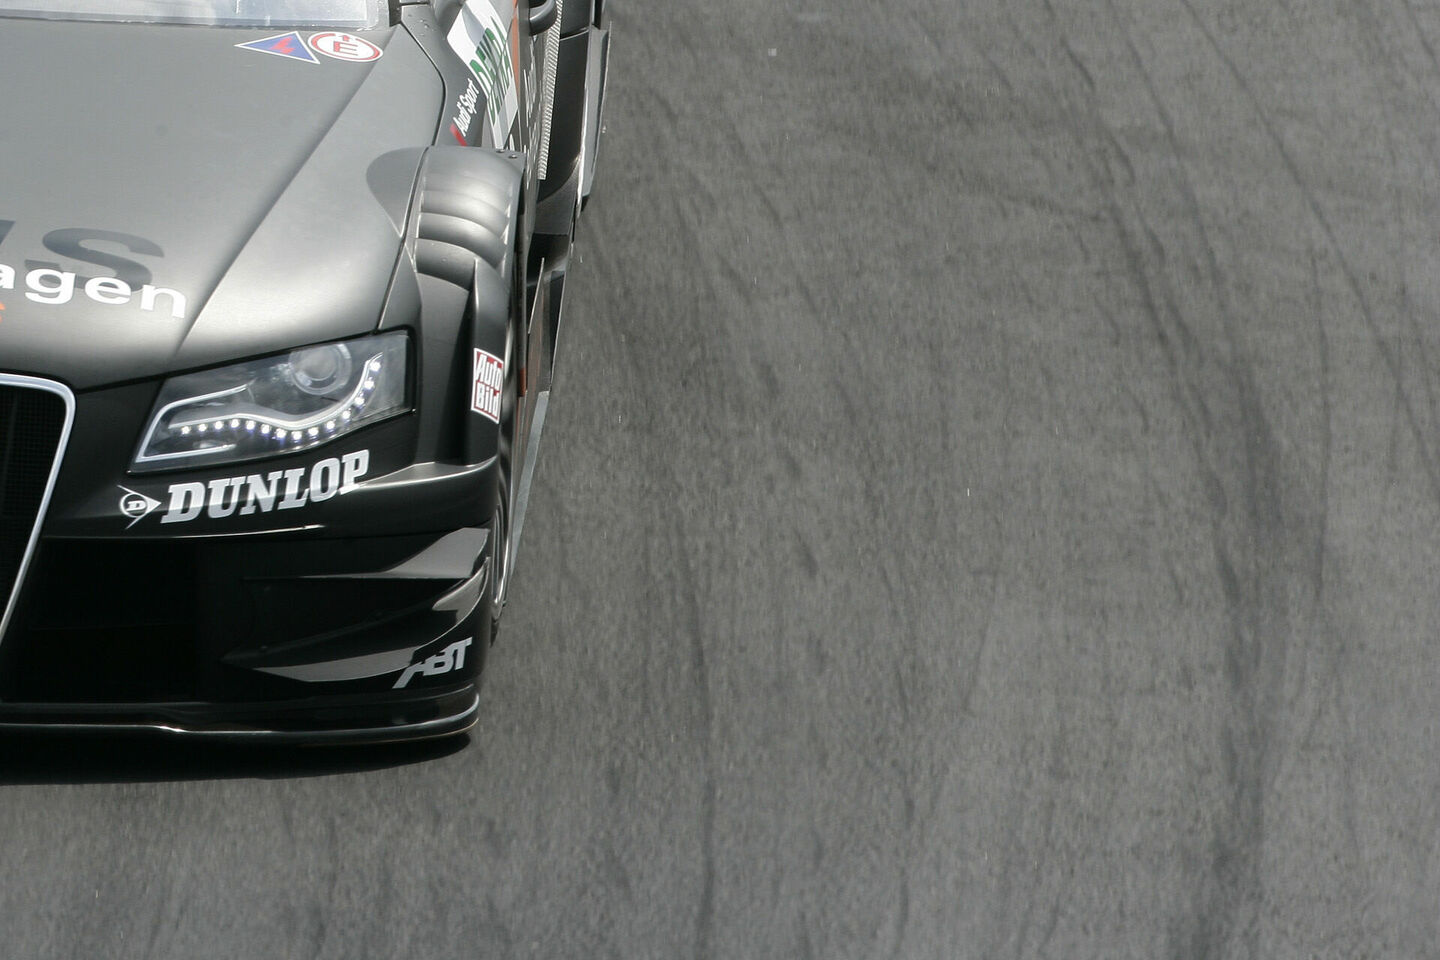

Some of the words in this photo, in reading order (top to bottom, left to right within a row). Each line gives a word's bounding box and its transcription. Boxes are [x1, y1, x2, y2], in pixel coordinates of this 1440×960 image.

[459, 78, 480, 115] Sport
[160, 449, 370, 524] DUNLOP
[391, 636, 473, 689] ABT
